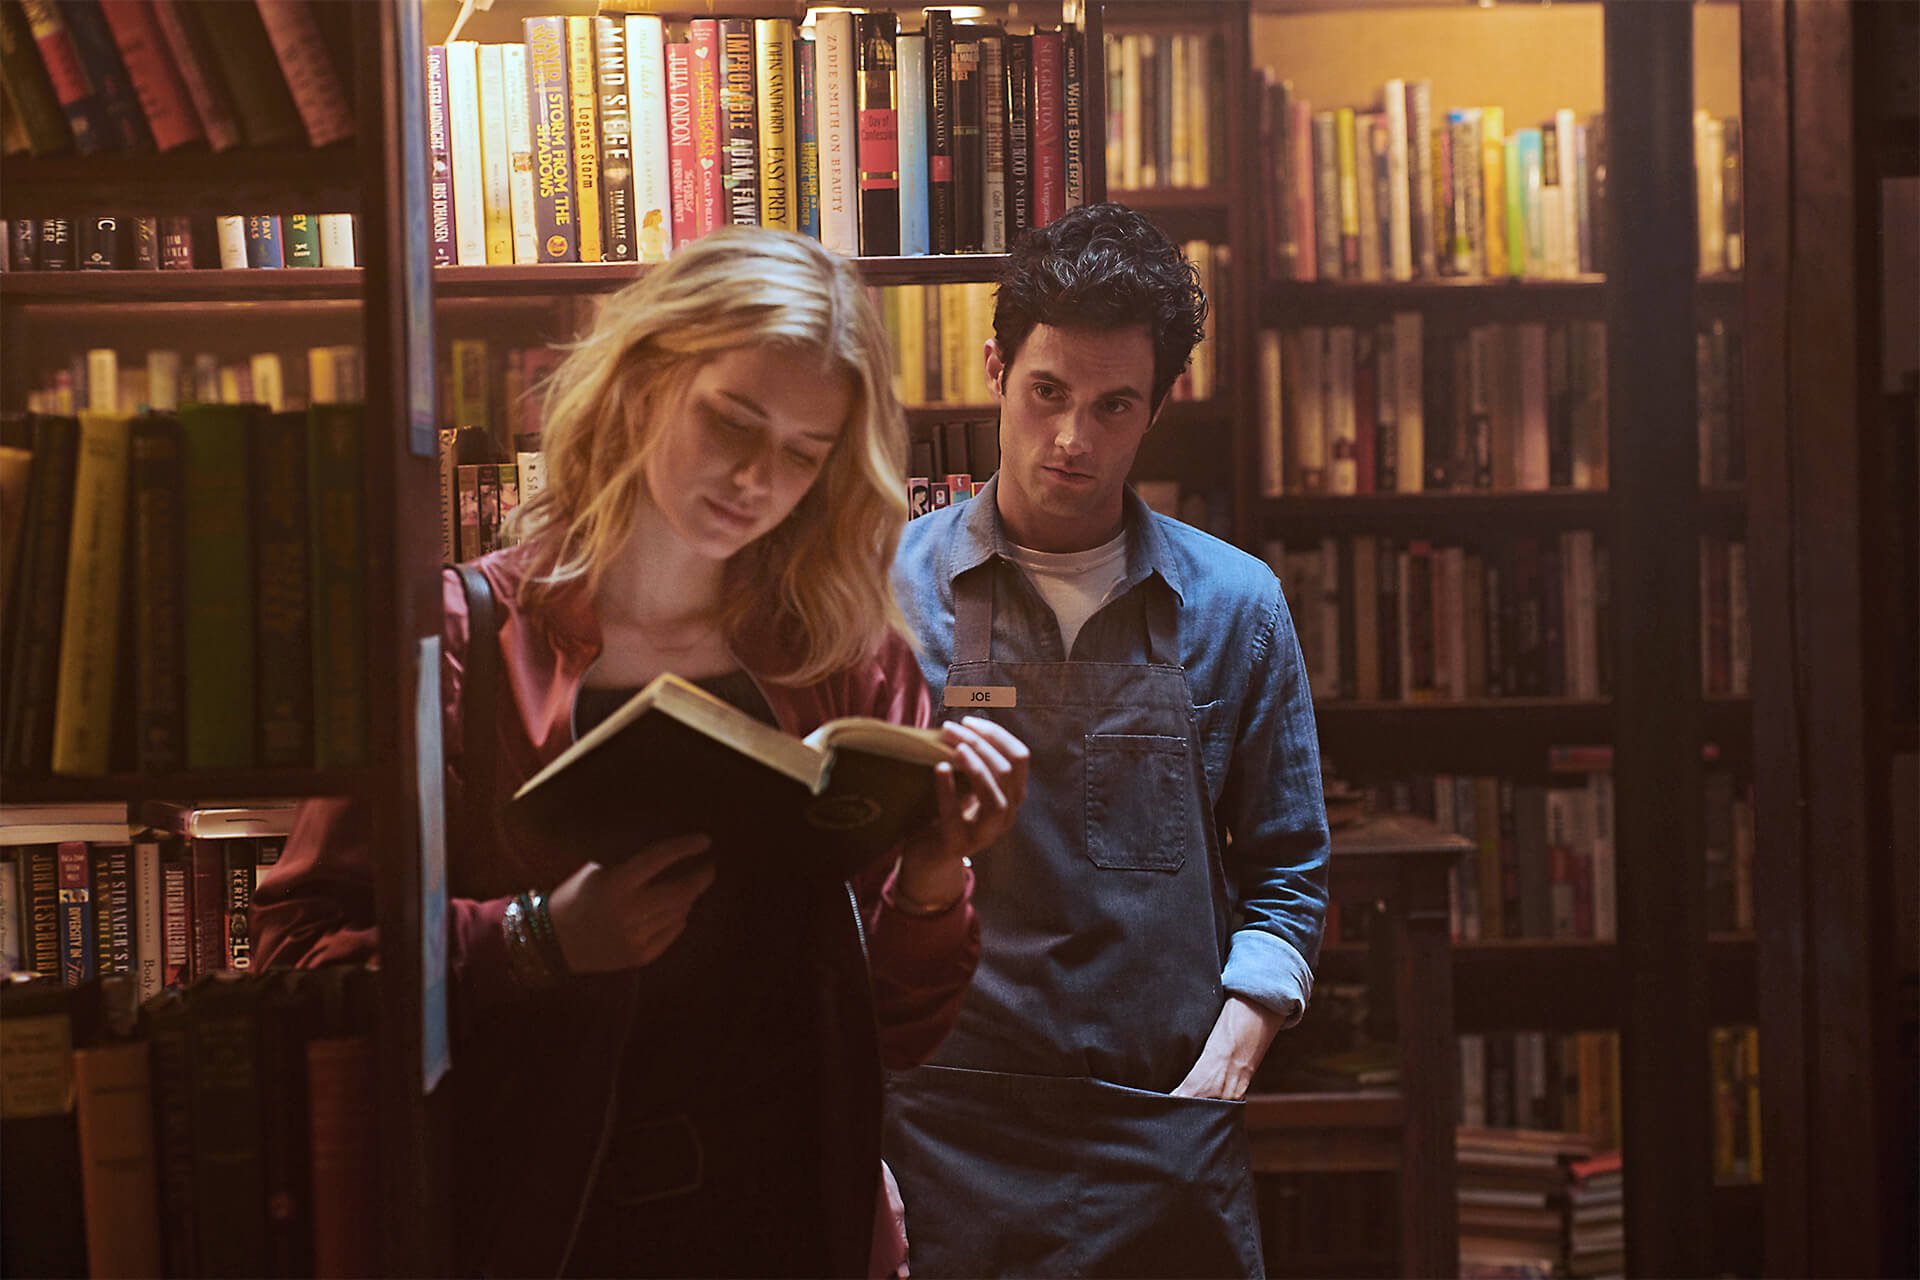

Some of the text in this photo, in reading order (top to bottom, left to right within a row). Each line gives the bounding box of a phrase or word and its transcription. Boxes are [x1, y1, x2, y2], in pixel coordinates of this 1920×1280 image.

[546, 29, 562, 82] DAVID
[727, 32, 754, 131] IMPROBABLE
[934, 43, 946, 112] ENDANGERED
[1040, 42, 1053, 66] SUE
[428, 54, 446, 151] LONG AFTER MIDNIGHT
[599, 26, 630, 161] MIND SIEGE
[668, 53, 692, 147] JULIA LONDON
[764, 41, 785, 135] JOHN SANDFORD
[1041, 68, 1055, 132] GRAFTON
[576, 107, 595, 190] Logan's Storm
[826, 35, 844, 214] ZADIE SMITH ON BEAUTY
[936, 113, 947, 149] VALUES
[1067, 82, 1083, 201] WHITE BUTTERFLY
[432, 182, 447, 199] IRIS
[537, 123, 555, 199] SHADOWS
[549, 93, 570, 226] STORM FROM THE
[730, 137, 756, 181] ADAM
[768, 147, 787, 225] EASY PREY
[433, 199, 449, 243] JOHANSEN
[614, 190, 625, 206] TIM
[1015, 198, 1026, 229] ELROD
[970, 692, 991, 702] JOE
[31, 853, 56, 892] JOHN
[110, 854, 128, 876] THE
[232, 869, 244, 910] KERIK
[112, 881, 129, 961] STRANGER'S
[164, 869, 188, 966] JONATHAN KELLERMAN
[142, 959, 156, 990] Body
